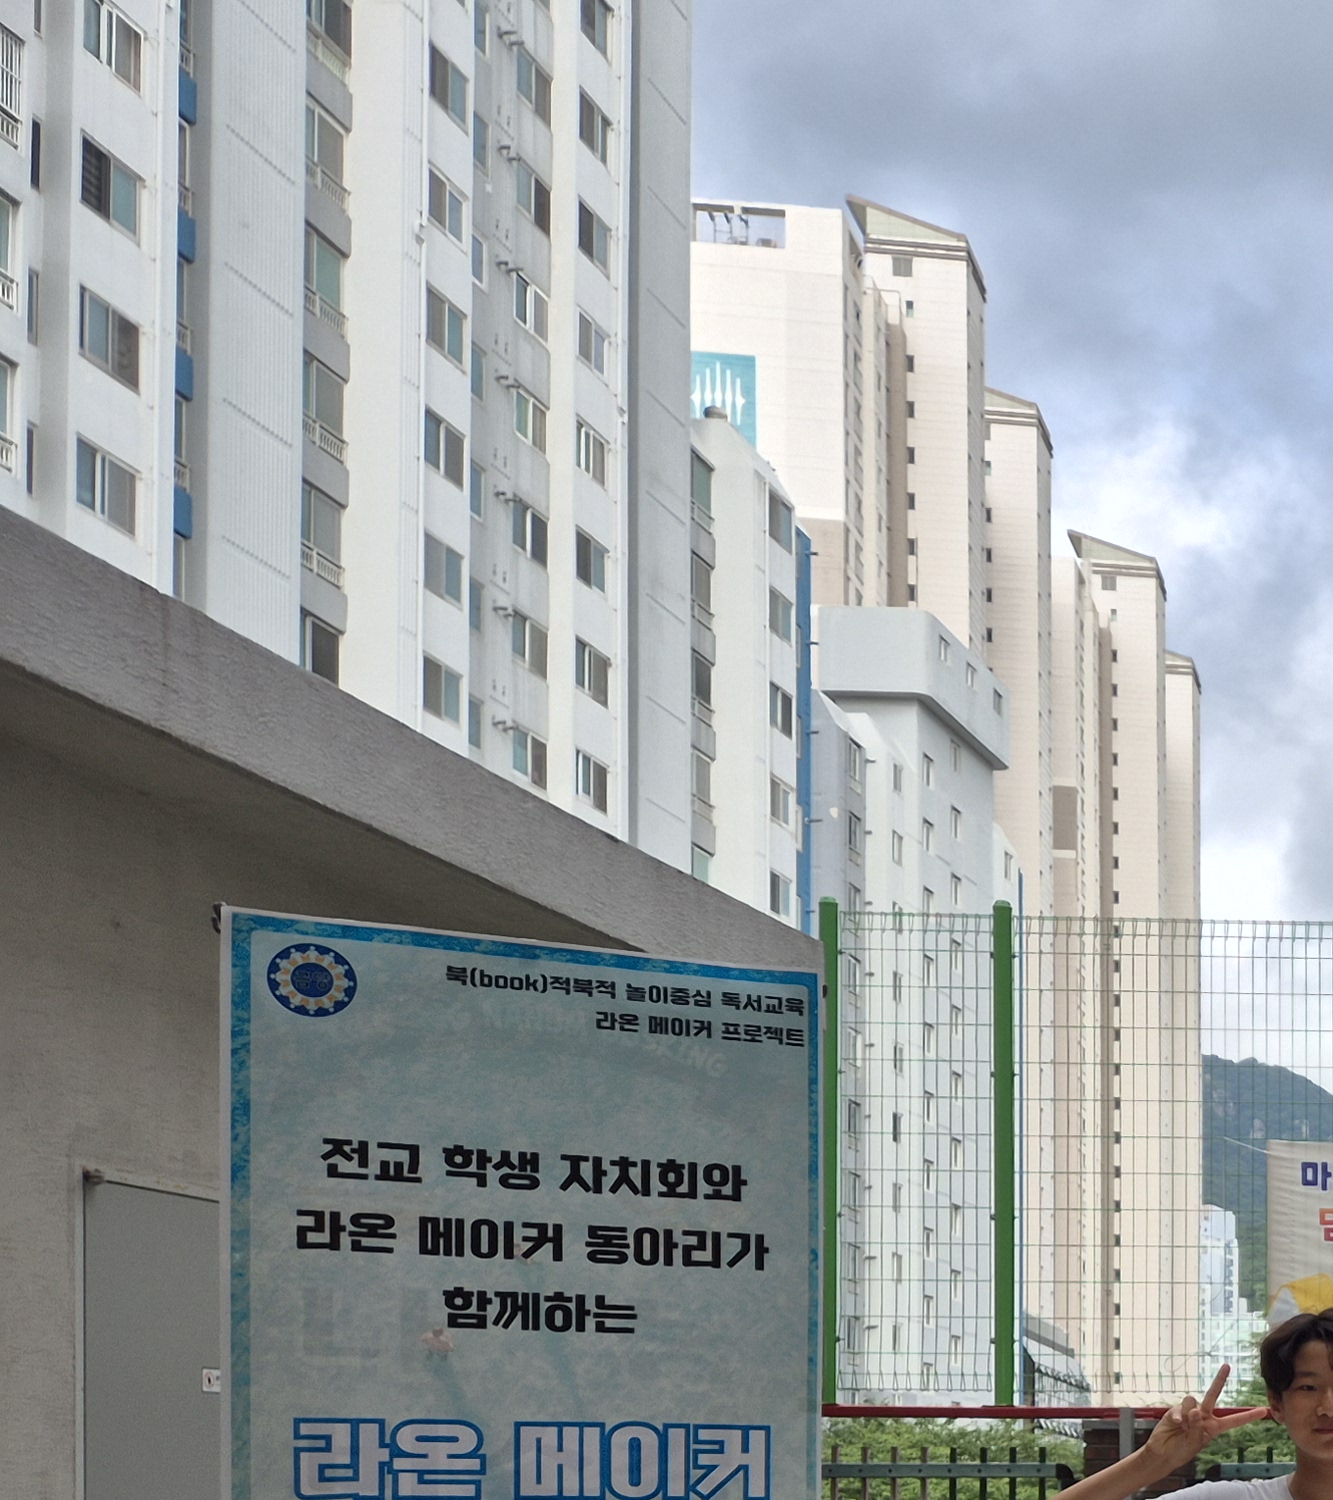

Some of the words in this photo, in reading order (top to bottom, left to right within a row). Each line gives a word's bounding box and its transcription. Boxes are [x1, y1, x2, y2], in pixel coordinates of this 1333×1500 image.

[445, 965, 616, 999] 북(book)적북적
[625, 983, 712, 1008] 놀이중심
[720, 991, 804, 1016] 독서교육
[595, 1012, 639, 1032] 라온
[649, 1016, 712, 1038] 메이커
[721, 1022, 804, 1047] 프로젝트
[320, 1138, 422, 1183] 전교
[442, 1145, 540, 1190] 학생
[559, 1153, 748, 1202] 자치회와
[295, 1209, 398, 1253] 라온
[418, 1216, 564, 1262] 메이커
[585, 1225, 770, 1271] 동아리가
[442, 1286, 639, 1335] 함께하는
